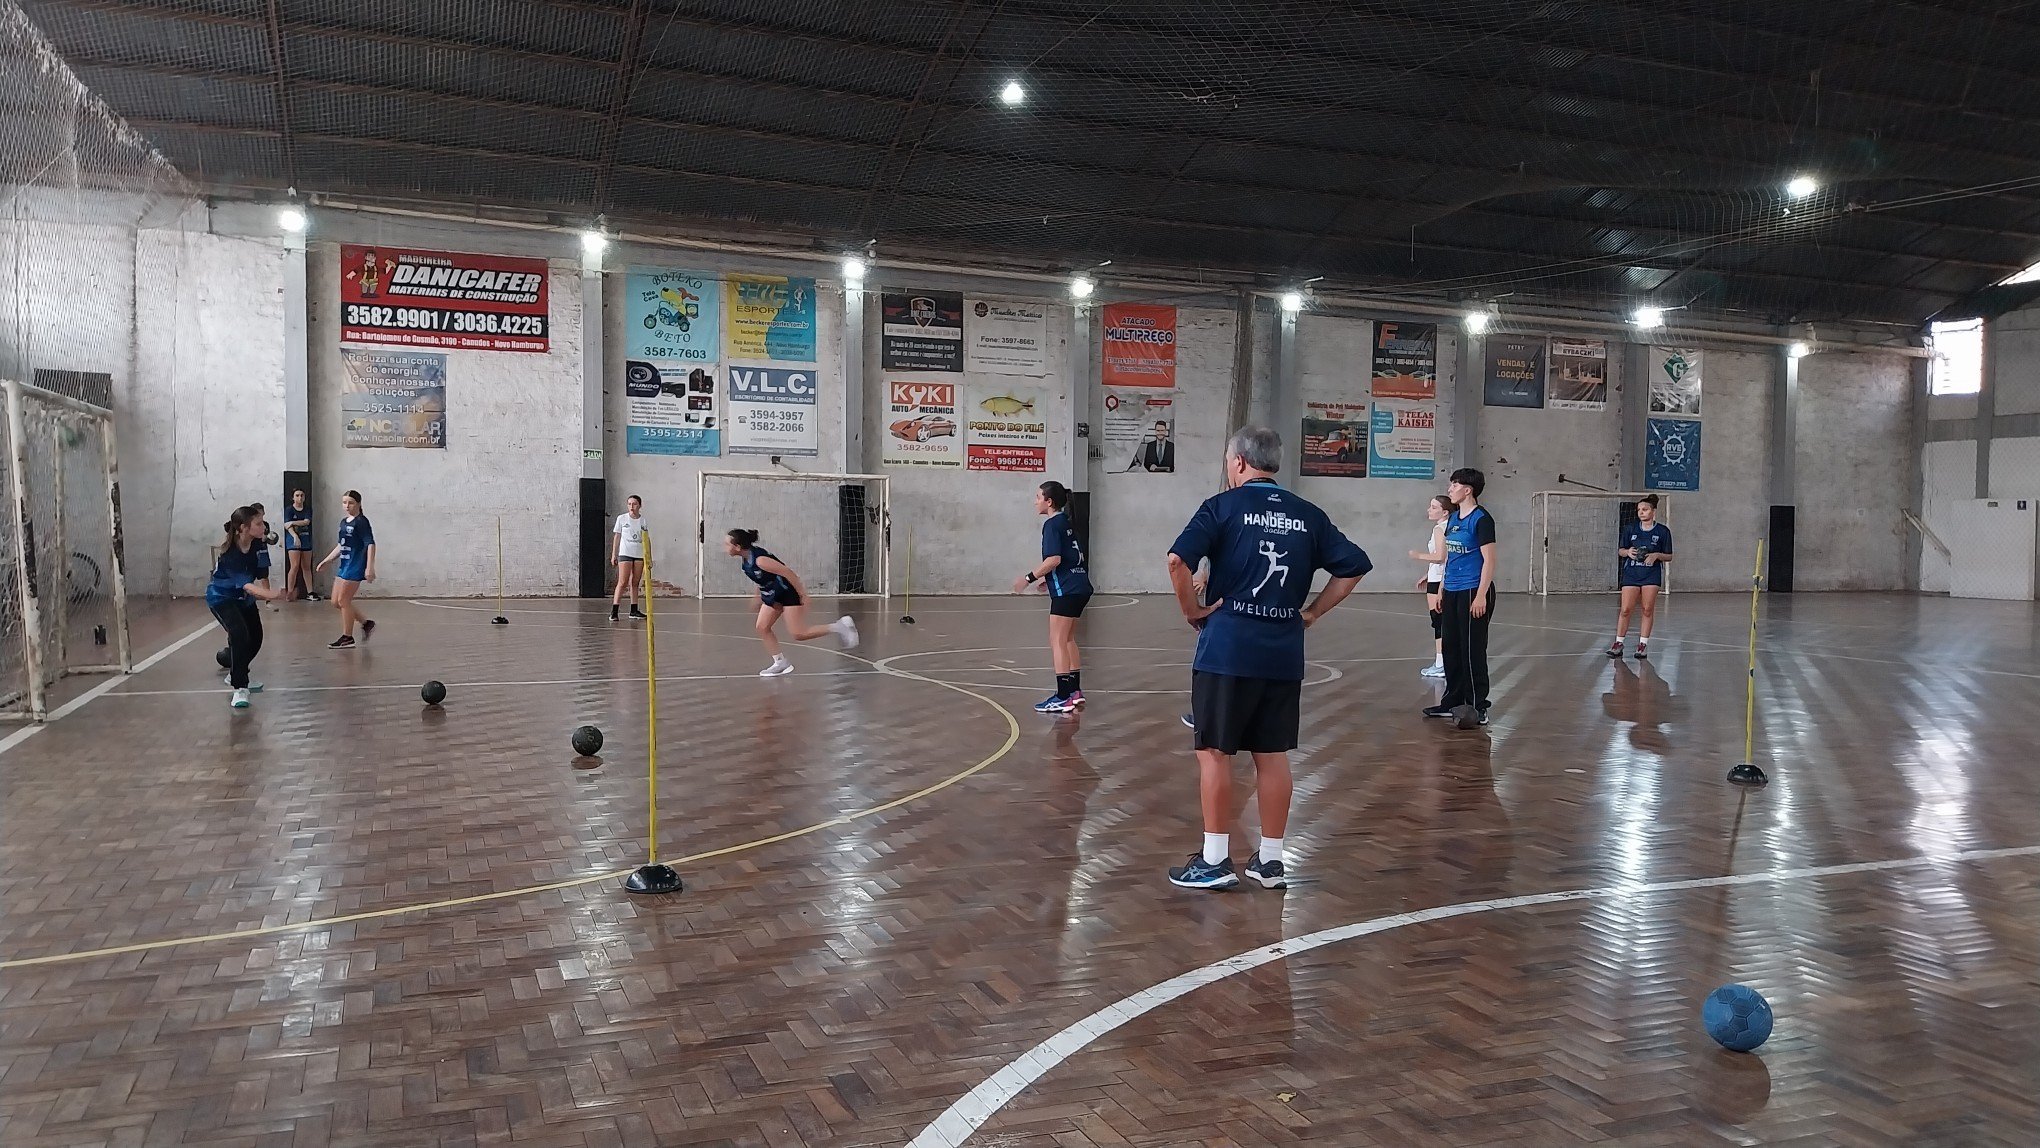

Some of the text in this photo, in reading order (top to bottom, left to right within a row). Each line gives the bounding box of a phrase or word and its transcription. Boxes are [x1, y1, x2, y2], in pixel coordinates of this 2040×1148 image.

[399, 255, 453, 266] MADEIREIRA
[392, 265, 542, 293] DANICAFER
[652, 271, 703, 290] BOTEKO
[389, 285, 538, 304] MATERIAIS DE CONSTRUÇÃO
[736, 305, 797, 315] ESPORTES
[347, 305, 542, 335] 3582.9901 / 3036.4225
[1122, 317, 1155, 326] ATACADO
[346, 331, 361, 339] Rua:
[362, 332, 401, 342] Bartolomeu
[402, 334, 411, 342] de
[412, 335, 440, 345] Gusmão,
[461, 338, 490, 347] Canudos
[494, 340, 510, 348] Novo
[511, 341, 544, 350] Hamburgo
[654, 329, 691, 344] BETO
[1105, 327, 1174, 345] MULTIPREÇO
[644, 346, 707, 359] 3587-7603
[348, 353, 439, 366] Reduza sua conta
[1497, 359, 1536, 369] VENDAS E
[366, 364, 378, 373] de
[1496, 369, 1535, 380] LOCAÇÕES
[351, 374, 436, 387] Conheça nossas
[731, 369, 815, 395] V.L.C.
[369, 388, 418, 398] soluções.
[774, 396, 814, 404] CONTABILIDADE
[363, 403, 424, 414] 3525-1114
[891, 405, 954, 414] AUTO MECÂNICA
[750, 410, 804, 420] 3594-3957
[1405, 411, 1434, 419] TELAS
[750, 422, 804, 432] 3582-2066
[969, 421, 1044, 433] PONTO DO FILÉ
[1398, 418, 1434, 427] KAISER
[643, 428, 703, 438] 3595-2514
[346, 434, 440, 445] www.ncsolar.com.br
[897, 444, 949, 452] 3582-9659
[984, 448, 1034, 456] TELE-ENTREGA
[1666, 444, 1682, 452] RVE
[969, 456, 993, 464] Fone:
[1244, 513, 1308, 533] HANDEBOL
[1263, 525, 1289, 535] Social
